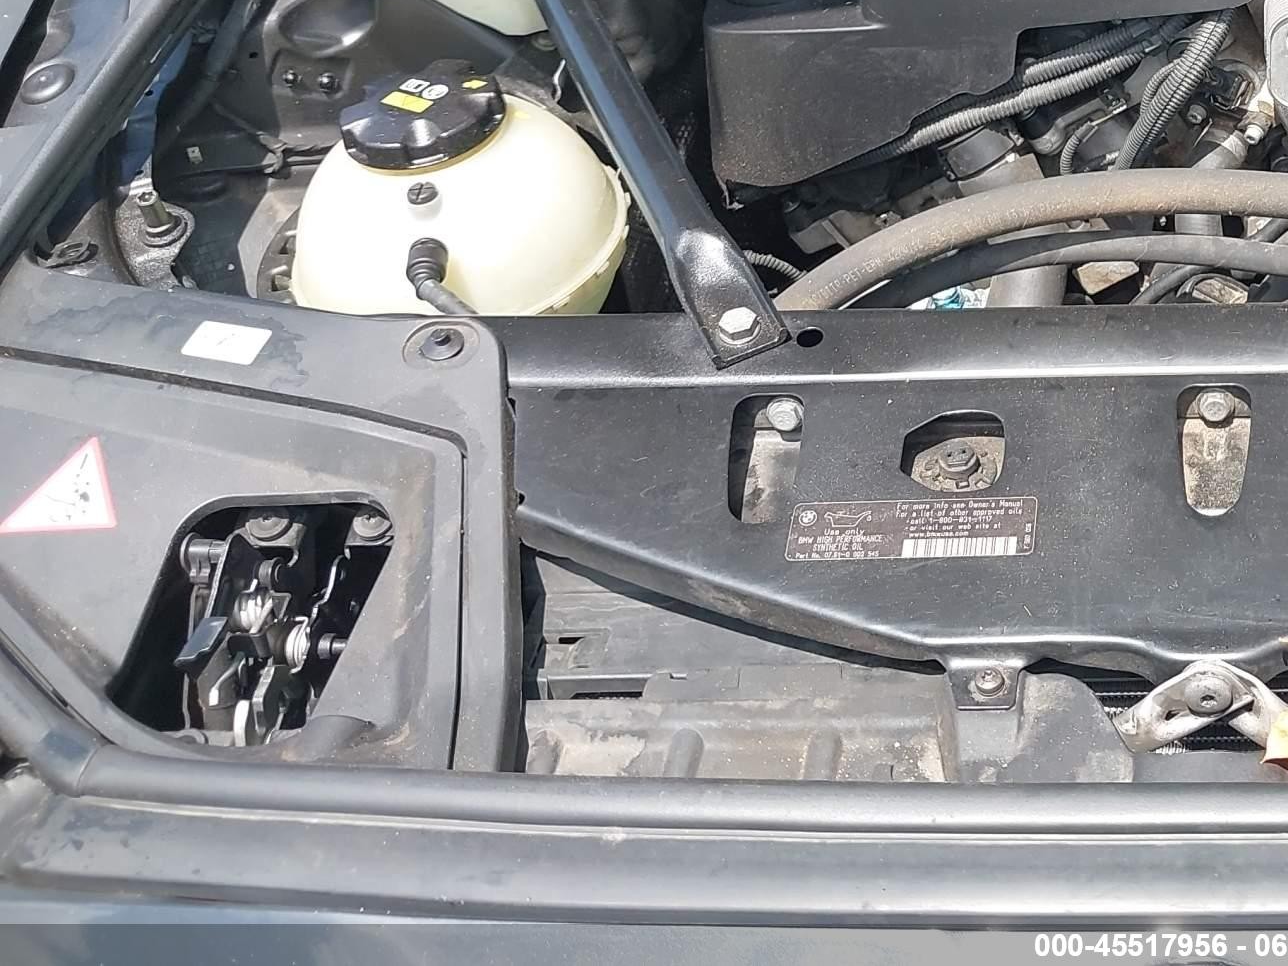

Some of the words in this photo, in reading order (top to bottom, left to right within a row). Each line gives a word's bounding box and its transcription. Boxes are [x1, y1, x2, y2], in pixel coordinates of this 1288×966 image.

[896, 502, 909, 510] For
[968, 500, 996, 508] Owner's
[999, 498, 1023, 507] Manual
[972, 507, 1005, 516] approved
[824, 528, 840, 536] Use
[844, 527, 865, 537] only
[797, 536, 815, 544] BMW
[816, 535, 833, 544] HIGH
[835, 534, 883, 543] PERFORMANCE
[812, 543, 849, 552] SYNTHETIC
[851, 542, 864, 551] OIL
